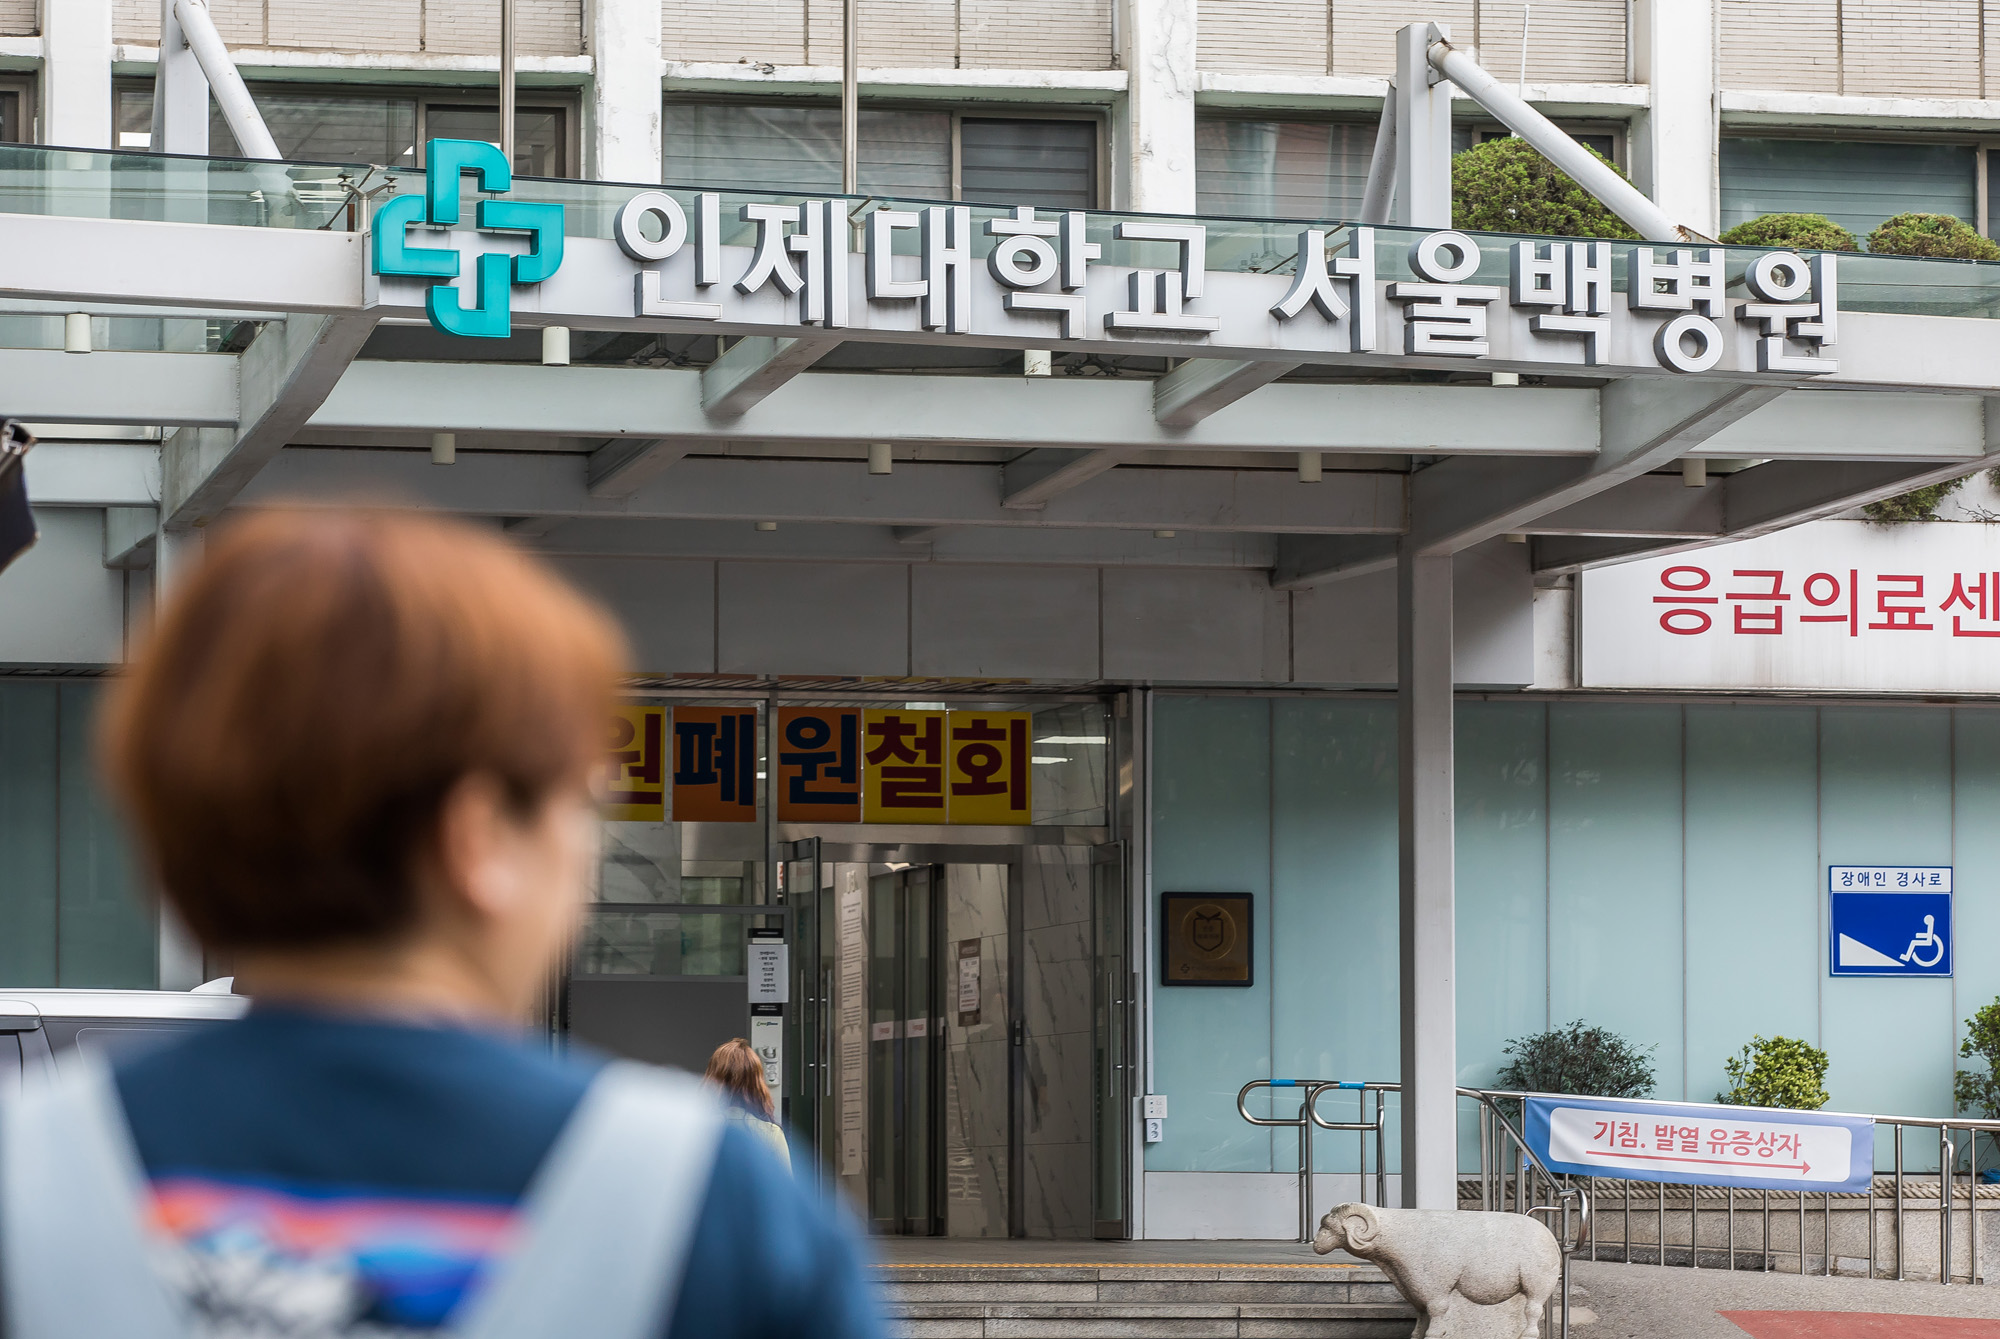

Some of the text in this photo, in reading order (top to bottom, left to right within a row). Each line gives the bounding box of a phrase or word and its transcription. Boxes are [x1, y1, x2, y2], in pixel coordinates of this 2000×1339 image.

[615, 191, 1840, 375] 인제대학교 서울백병원
[1653, 565, 2000, 637] 응급의료센
[1841, 871, 1942, 888] 장애인 경사로
[1655, 1125, 1699, 1153] 발열
[1706, 1129, 1802, 1160] 유증상자
